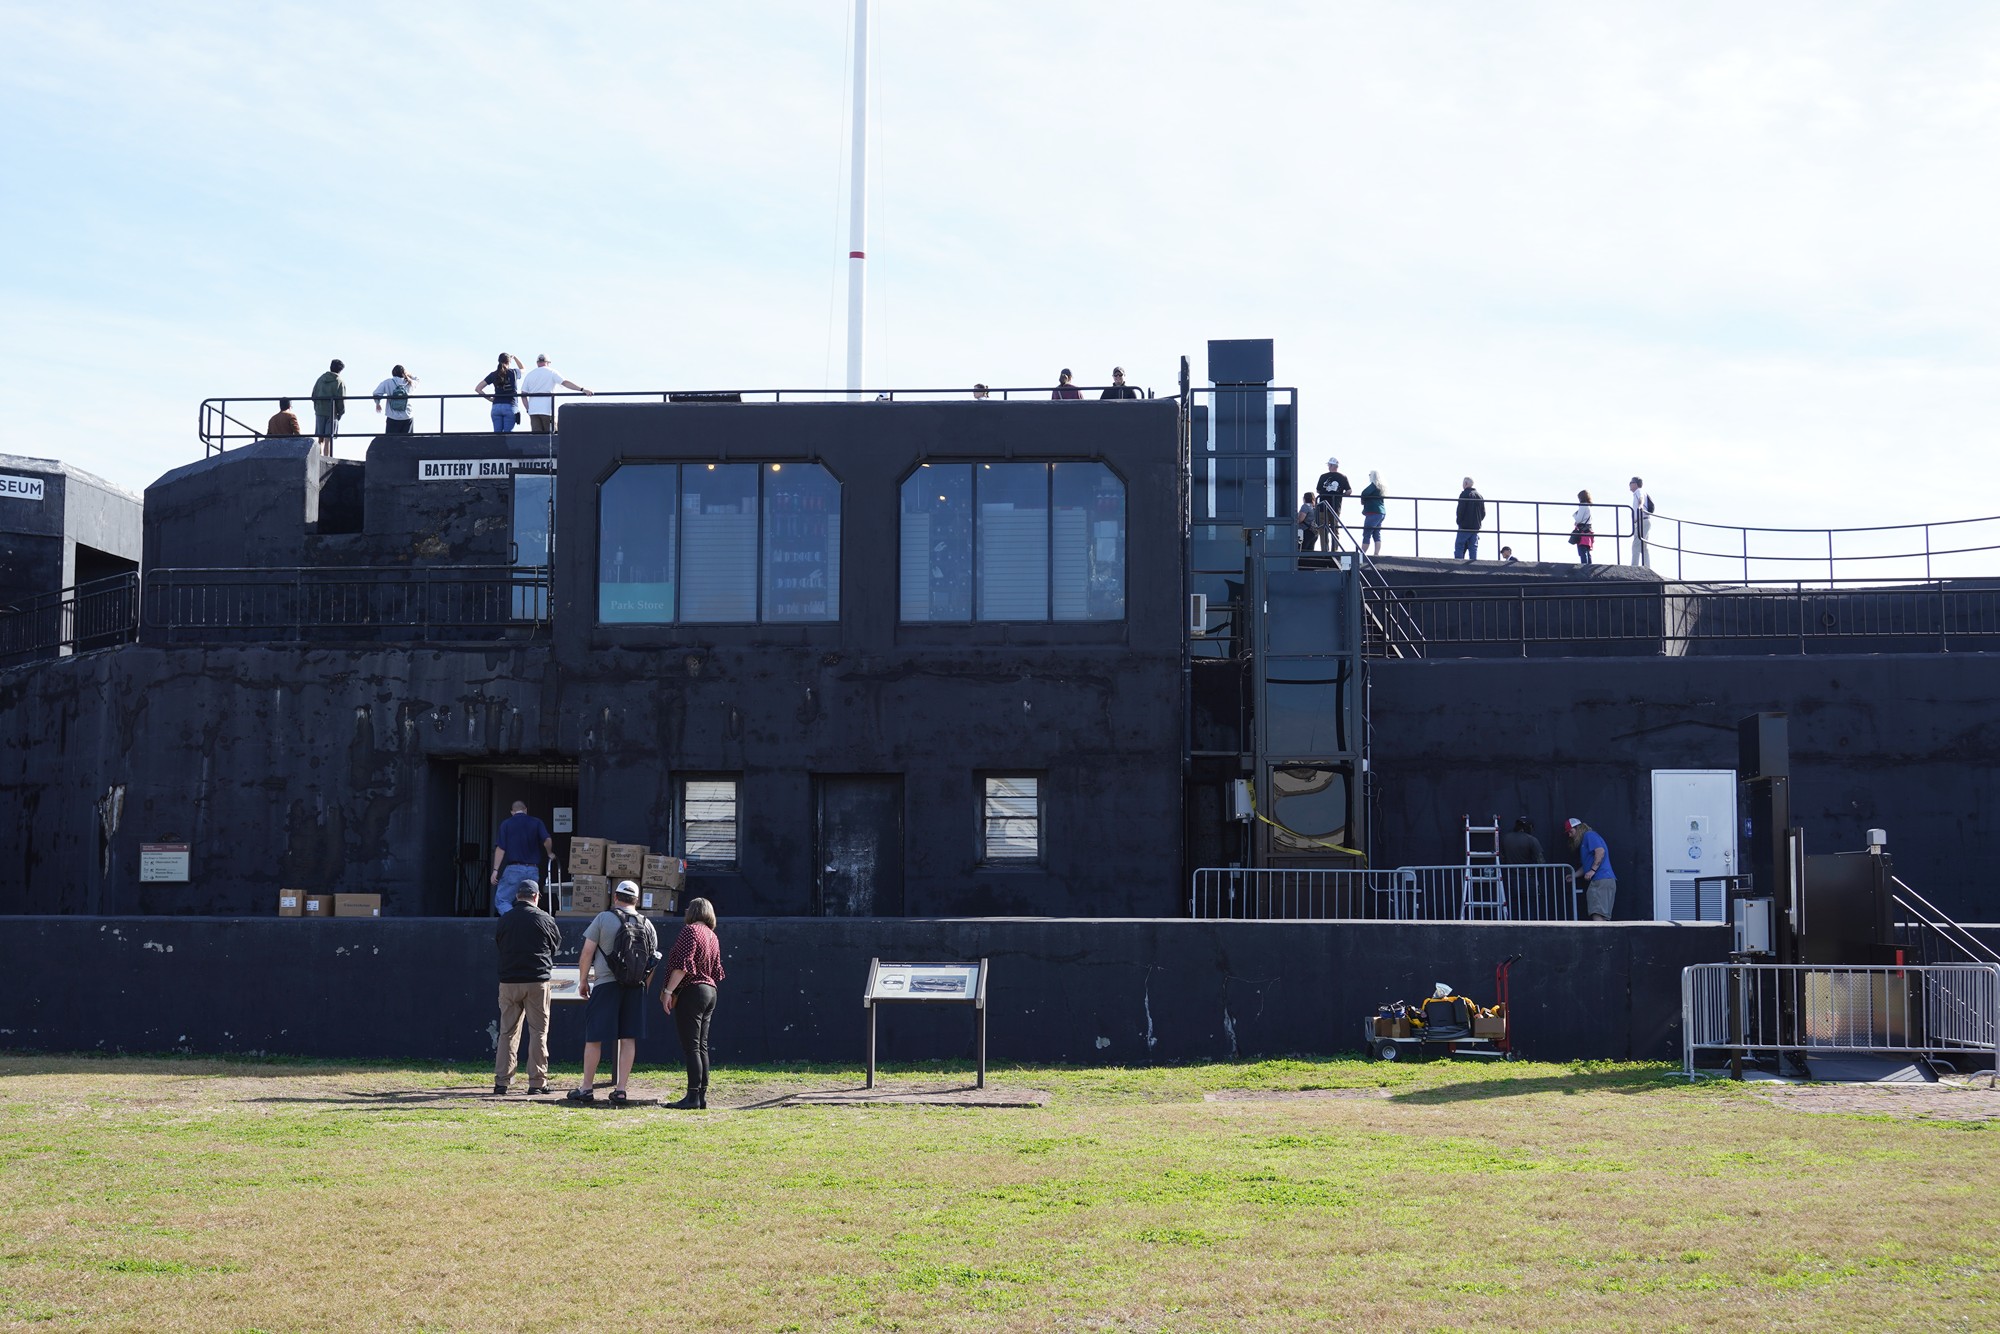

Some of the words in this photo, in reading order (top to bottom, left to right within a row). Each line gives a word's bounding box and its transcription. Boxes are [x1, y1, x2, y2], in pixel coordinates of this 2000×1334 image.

[424, 463, 473, 476] BATTERY
[479, 463, 513, 475] ISAAC
[0, 480, 42, 495] SEUM
[610, 600, 634, 609] Park
[637, 600, 664, 609] Store
